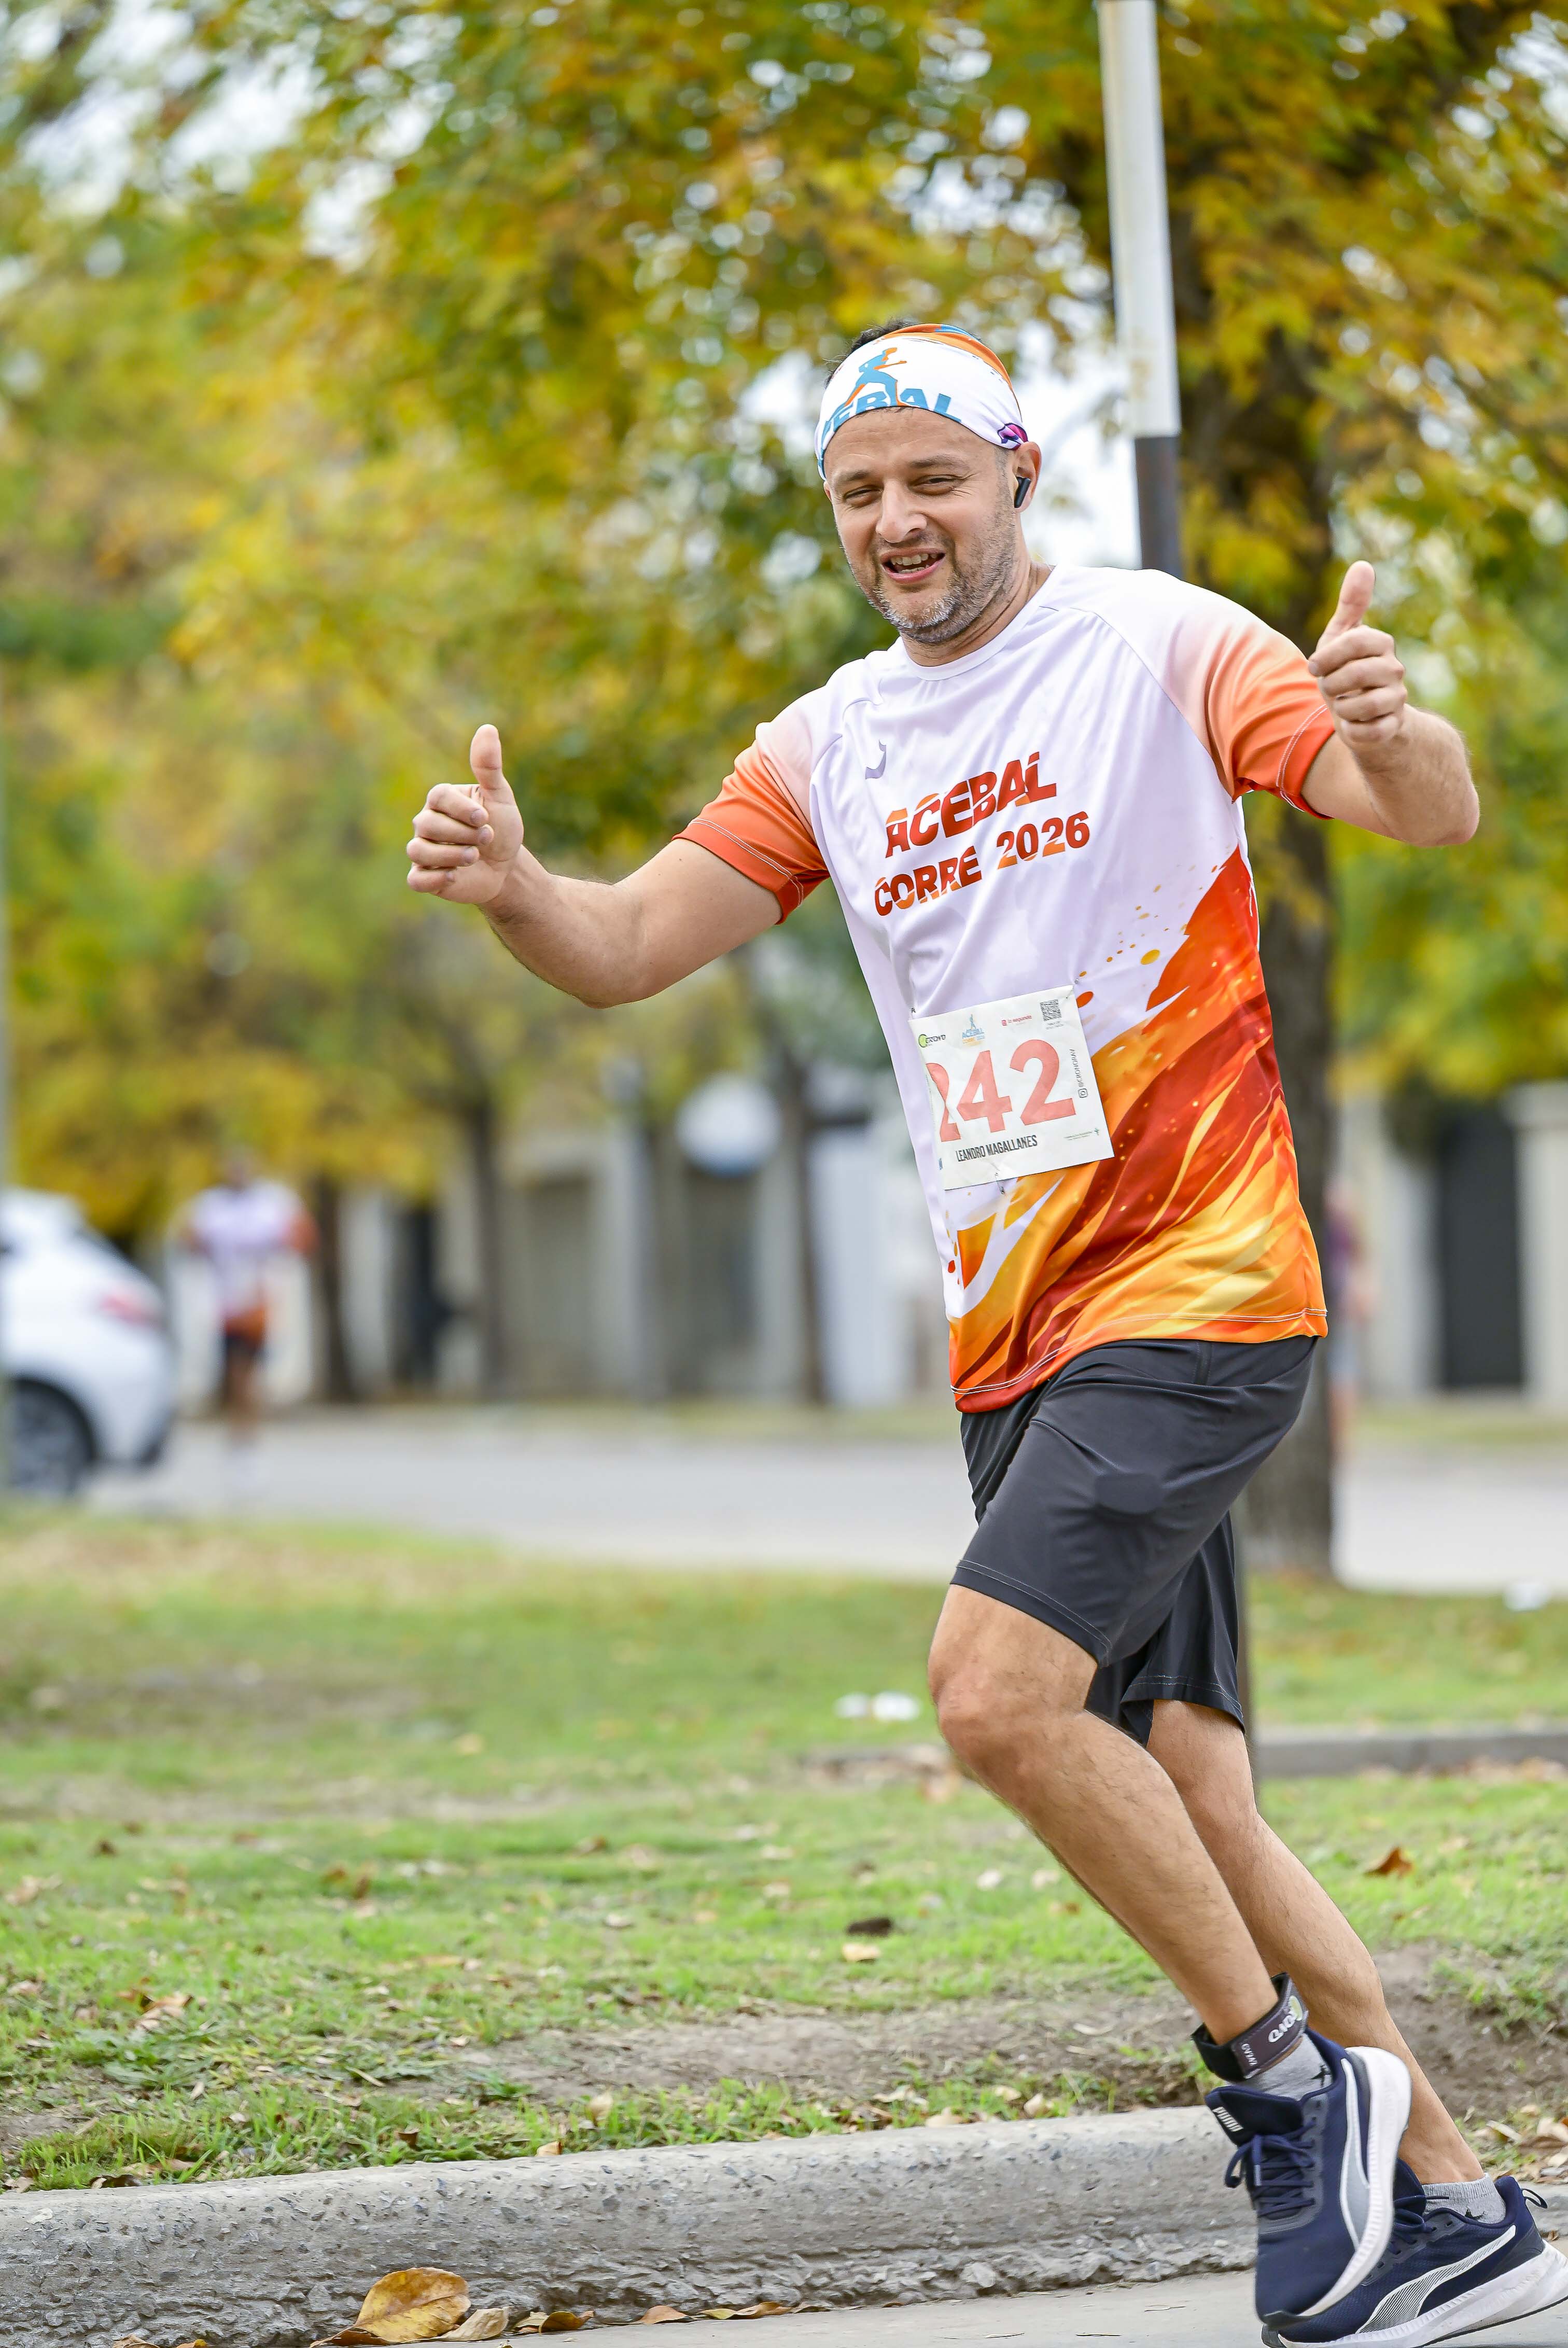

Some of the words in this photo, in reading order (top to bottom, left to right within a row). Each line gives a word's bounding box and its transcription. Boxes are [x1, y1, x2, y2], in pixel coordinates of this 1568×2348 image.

[885, 751, 1057, 858] ACEBAL
[875, 846, 982, 916] CORRE
[996, 811, 1090, 870] 2026
[956, 1145, 986, 1162] LEANDRO
[985, 1135, 1038, 1156] MAGALLANES
